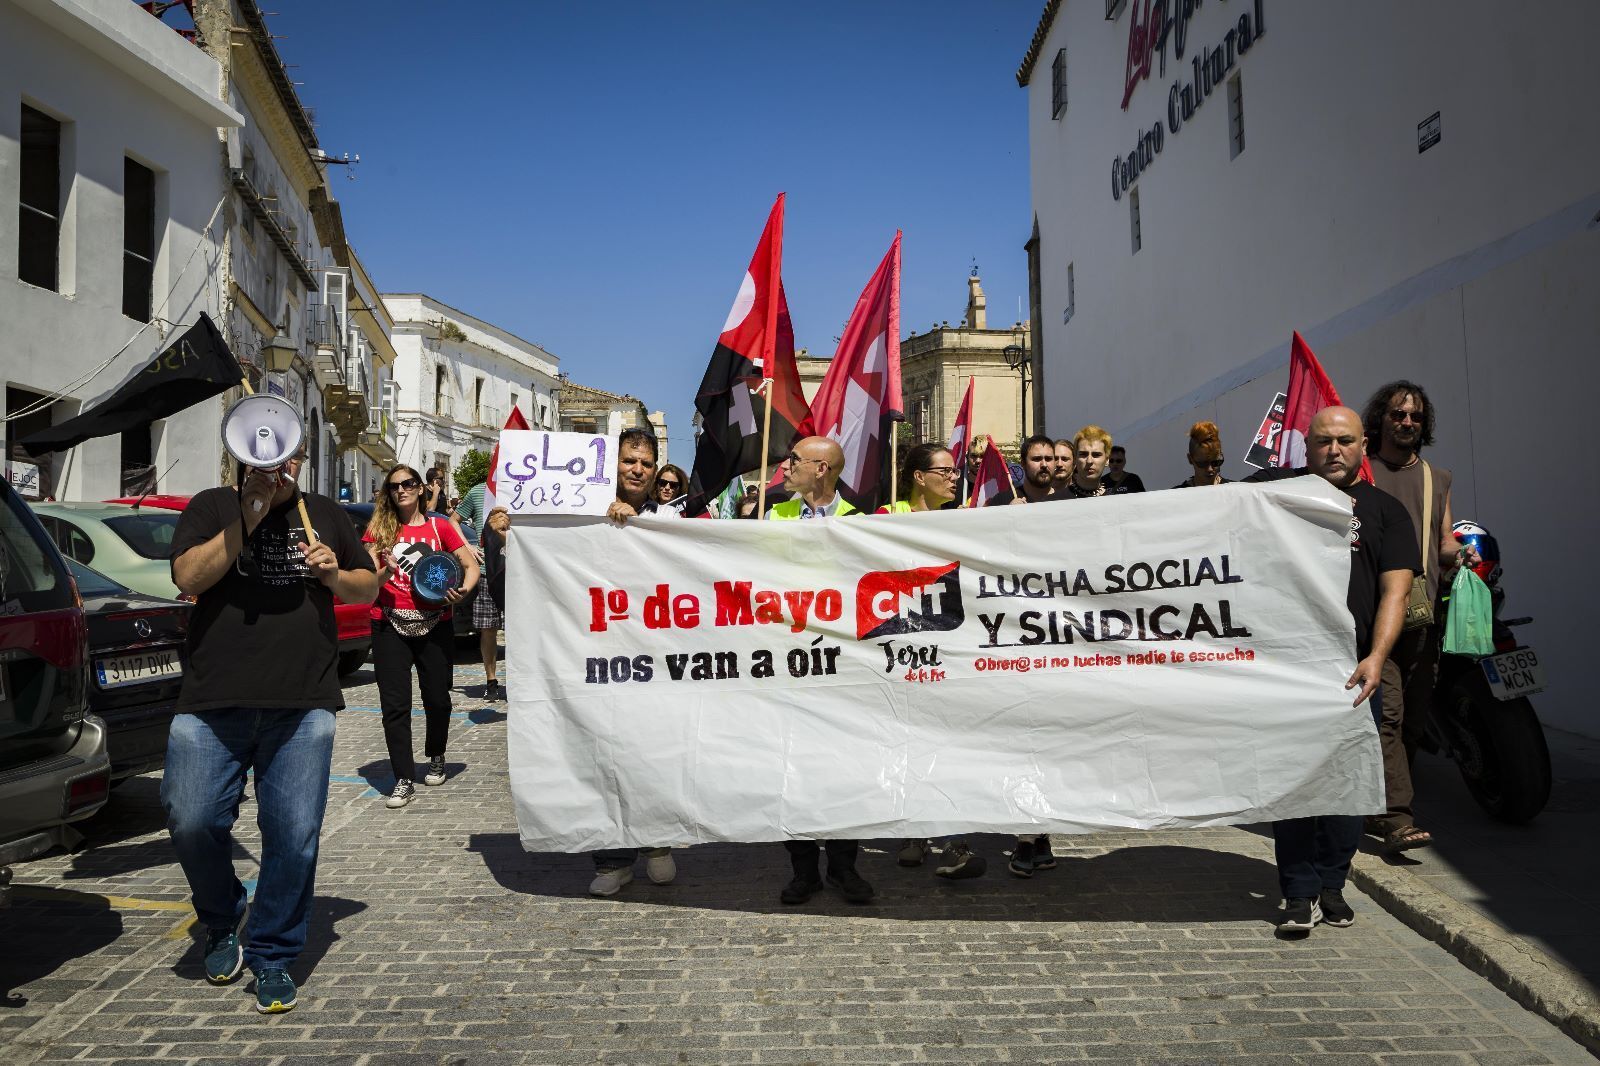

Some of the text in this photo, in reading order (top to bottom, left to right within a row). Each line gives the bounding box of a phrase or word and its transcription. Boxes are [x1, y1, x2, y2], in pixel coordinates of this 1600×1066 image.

[1112, 121, 1163, 200] Centro
[1168, 0, 1264, 134] Cultural
[510, 482, 587, 511] 2023
[977, 554, 1243, 598] LUCHA SOCIAL
[589, 581, 843, 633] 1º de Mayo
[871, 583, 949, 621] CNT
[977, 600, 1252, 645] Y SINDICAL
[110, 657, 142, 680] 3117
[147, 652, 175, 675] DVK
[585, 635, 841, 684] nos van a oír
[974, 646, 1255, 672] Obrer@ si no luchas nadie te escucha
[1495, 650, 1538, 673] 5369
[1502, 669, 1536, 691] MCN
